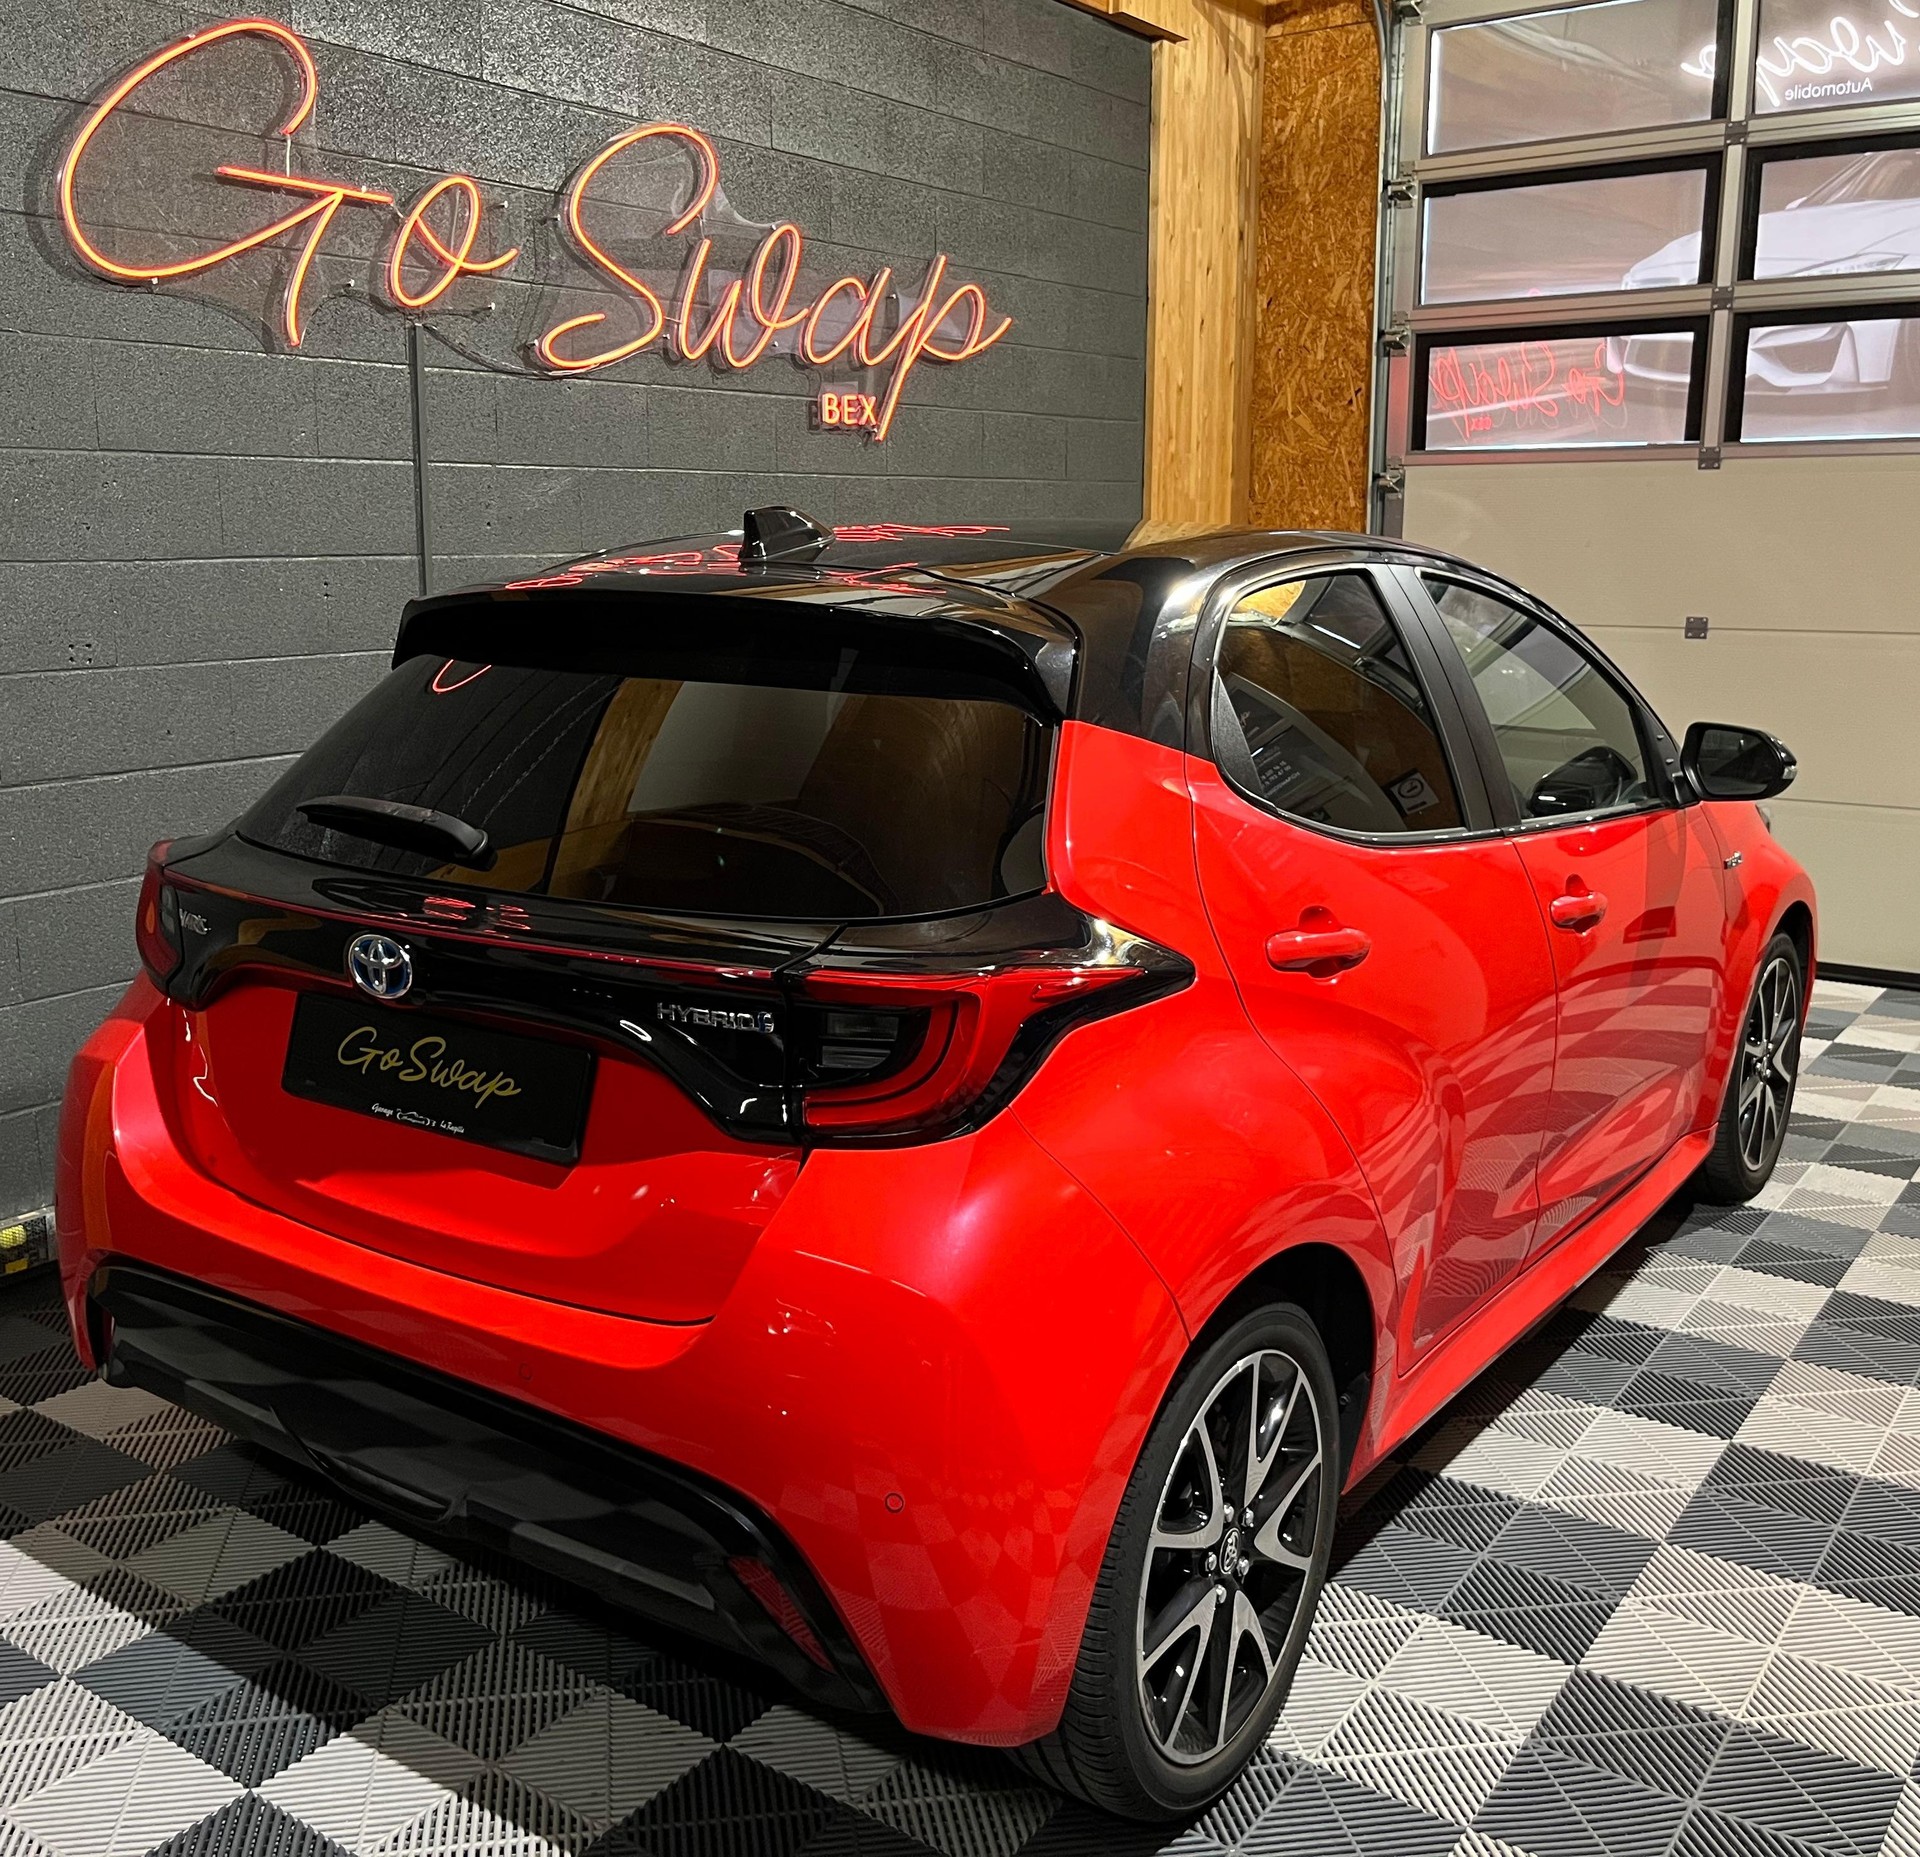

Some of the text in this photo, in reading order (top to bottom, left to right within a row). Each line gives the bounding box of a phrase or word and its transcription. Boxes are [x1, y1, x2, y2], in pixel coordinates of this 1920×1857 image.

[60, 17, 1013, 442] Go Swap
[821, 393, 878, 427] BEX
[656, 1002, 756, 1032] HYBRID
